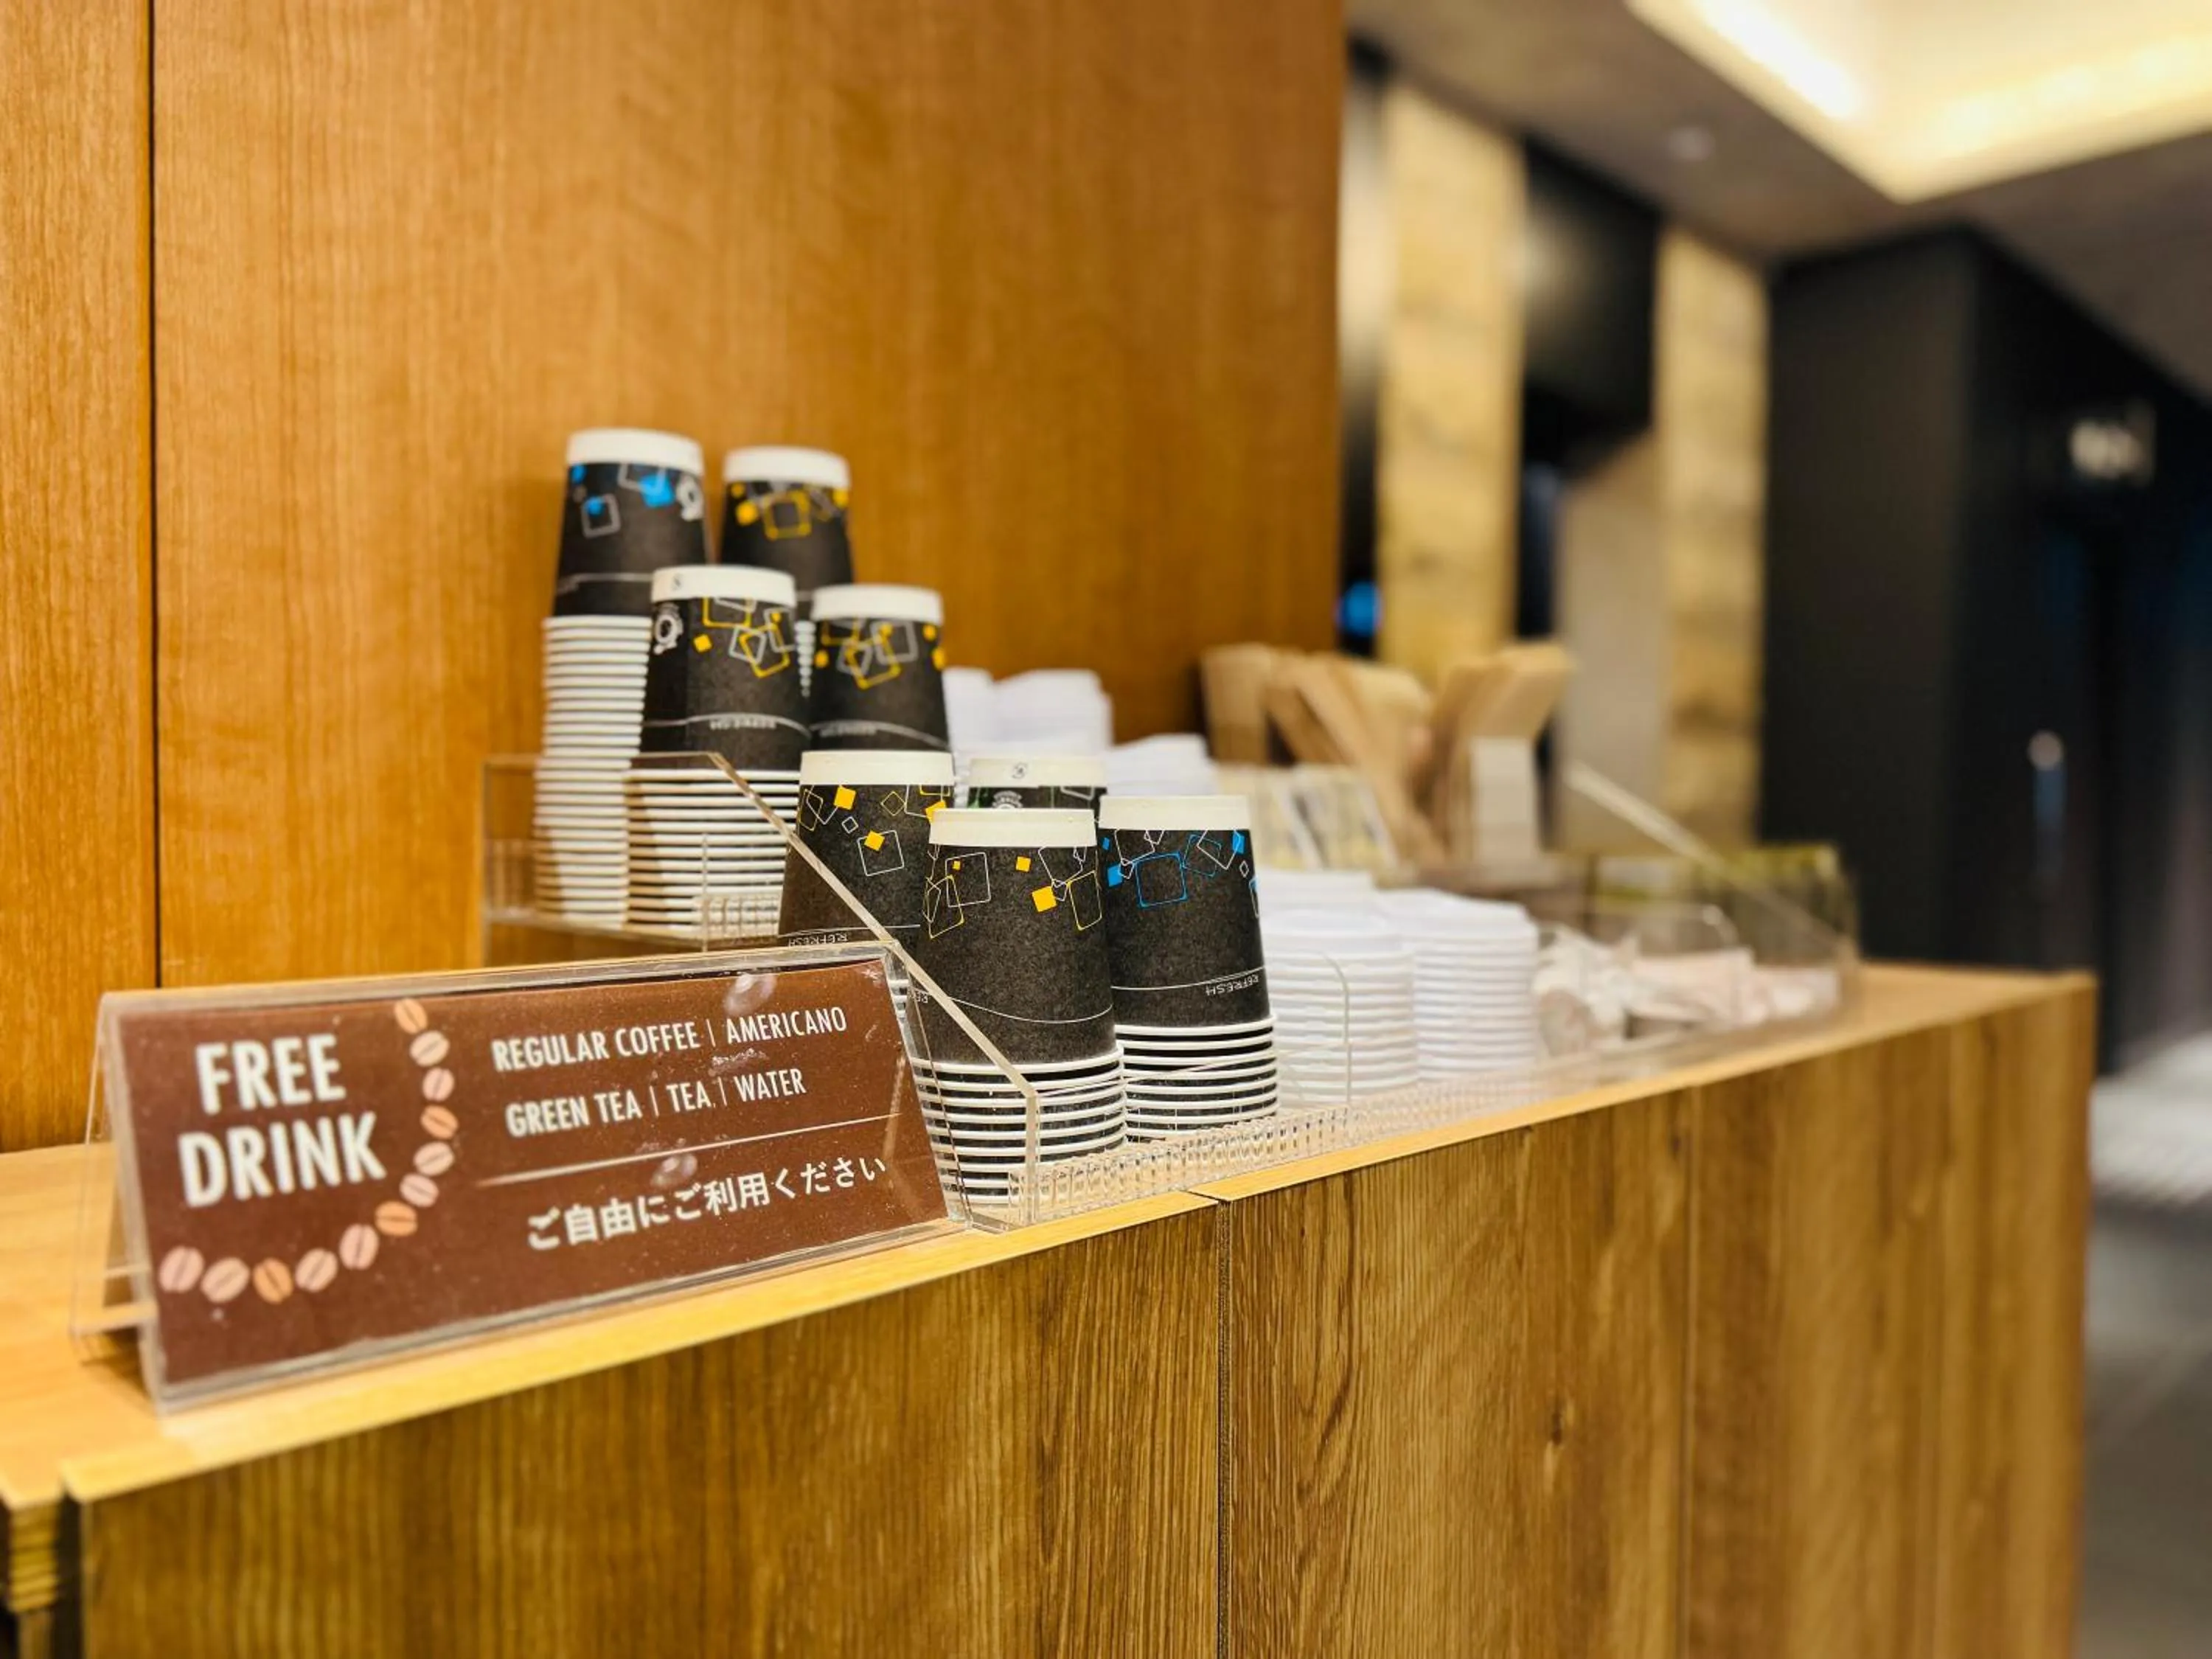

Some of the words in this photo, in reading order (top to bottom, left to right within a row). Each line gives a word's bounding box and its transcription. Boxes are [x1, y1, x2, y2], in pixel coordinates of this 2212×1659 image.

[1205, 973, 1259, 996] REFRESH
[195, 1033, 347, 1115] FREE
[491, 1029, 610, 1072] REGULAR
[615, 1021, 700, 1057] COFFEE
[726, 1006, 847, 1045] AMERICANO
[505, 1098, 590, 1138] GREEN
[594, 1089, 642, 1124] TEA
[666, 1080, 711, 1113] TEA
[734, 1068, 806, 1103] WATER
[178, 1110, 387, 1208] DRINK
[526, 1156, 886, 1251] ご自由にご利用ください
